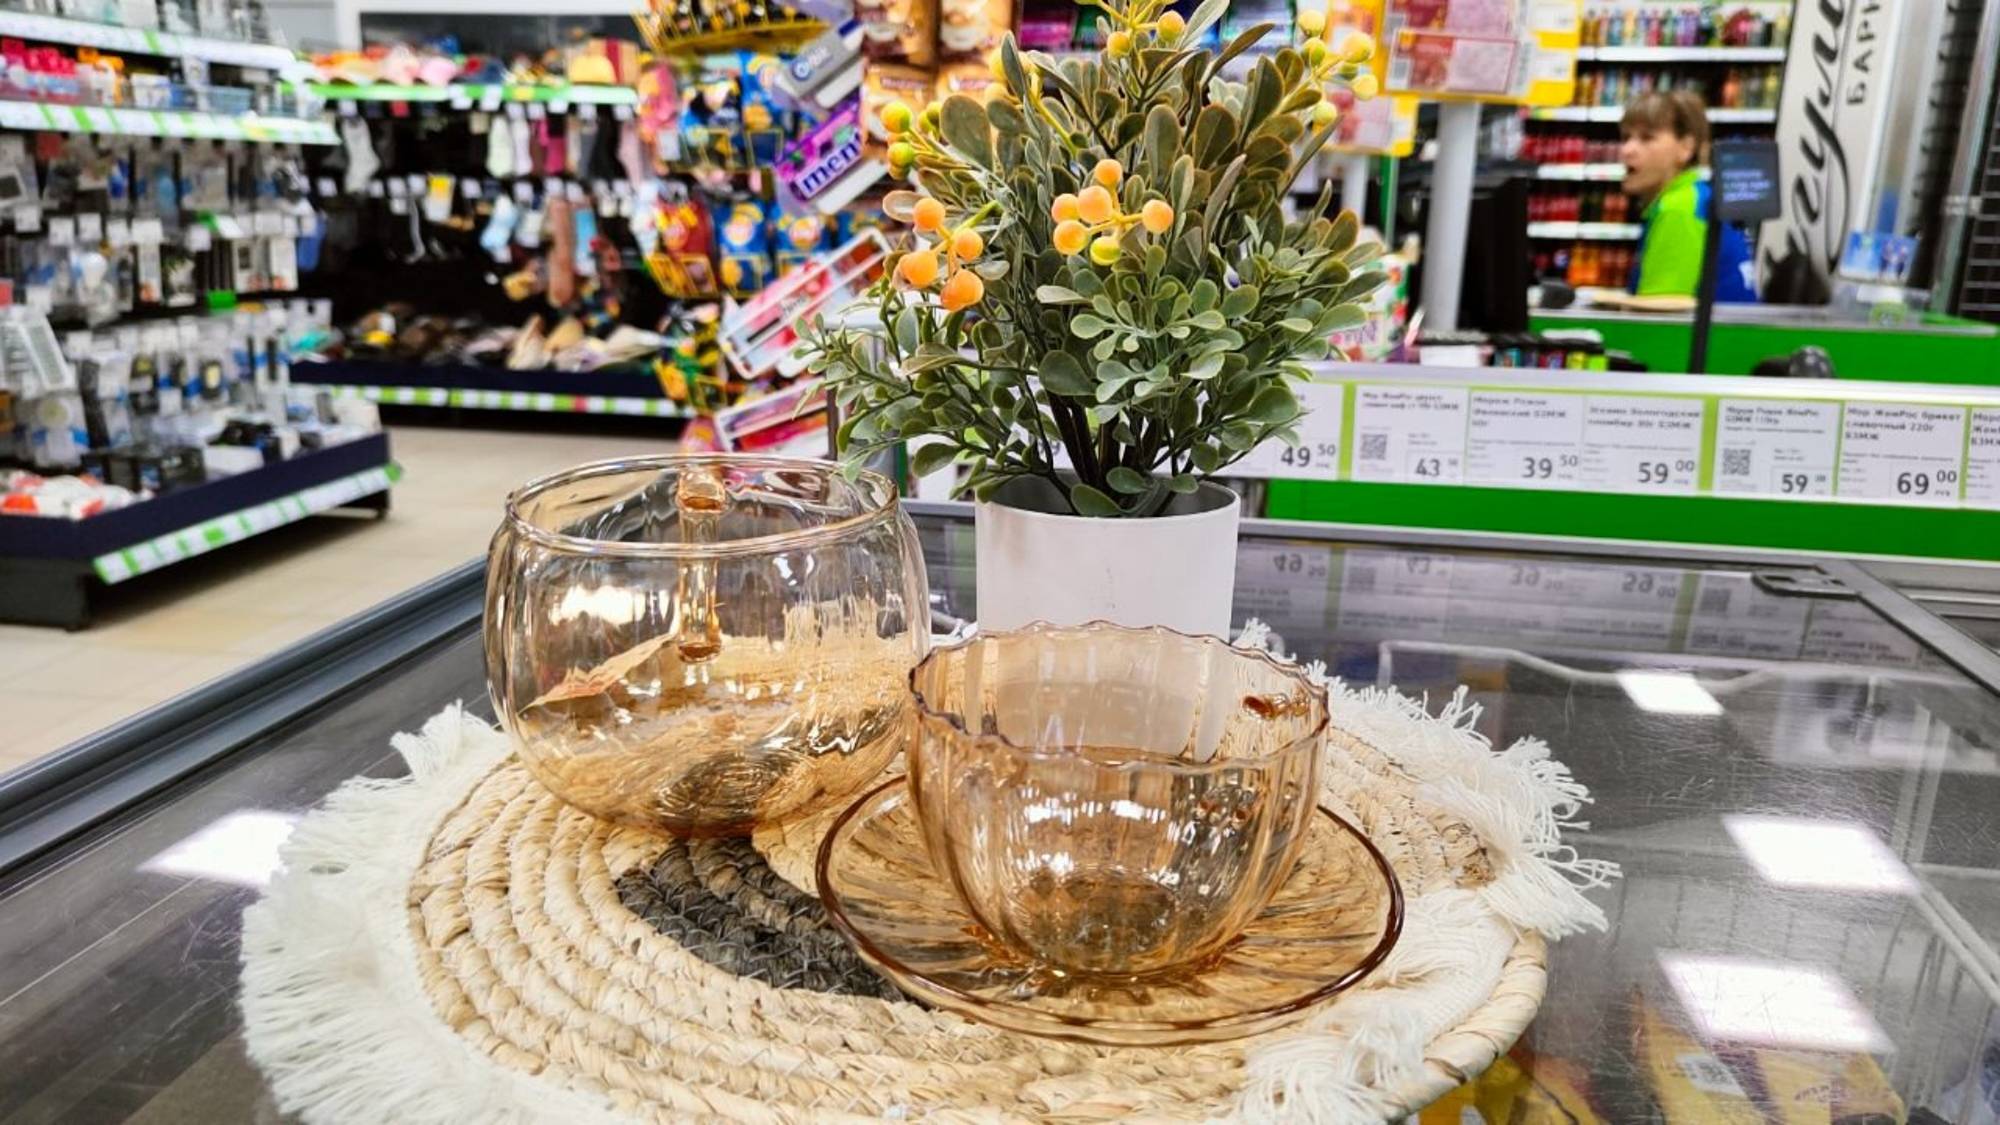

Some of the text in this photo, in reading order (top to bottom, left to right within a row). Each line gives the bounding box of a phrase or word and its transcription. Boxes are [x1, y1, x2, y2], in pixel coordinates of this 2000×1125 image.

[1281, 443, 1336, 467] 49 50
[1522, 454, 1579, 479] 39 50
[1415, 458, 1441, 477] 43
[1637, 459, 1695, 484] 59 00
[1781, 474, 1808, 493] 59
[1897, 470, 1957, 495] 69 00
